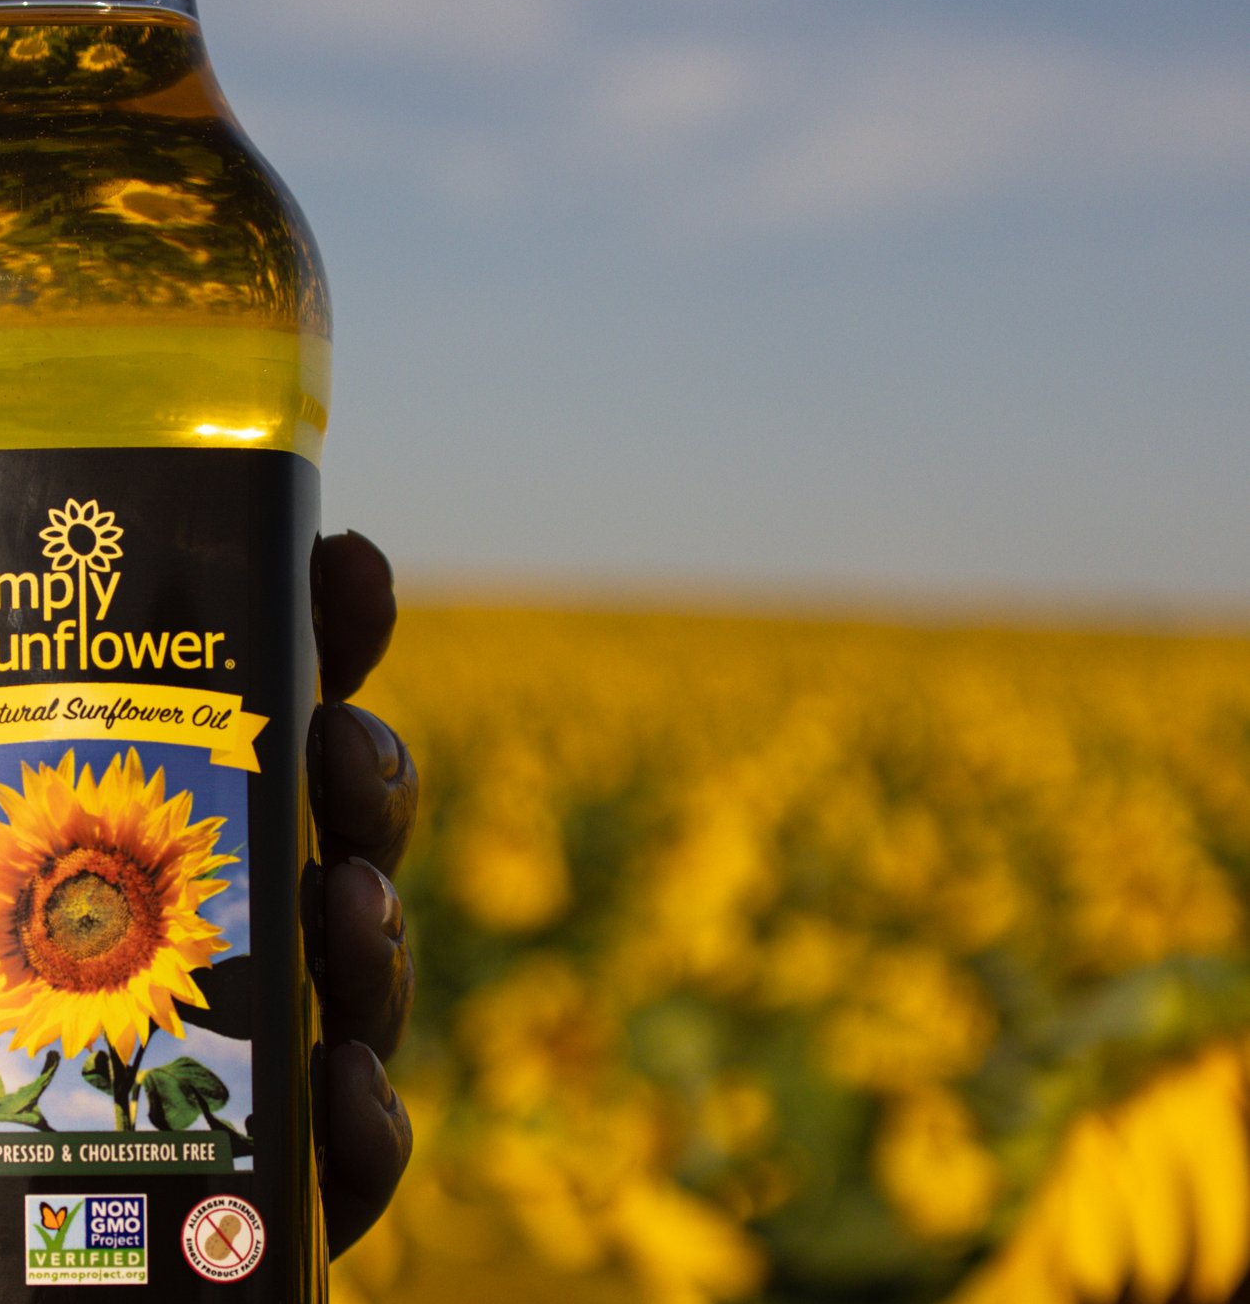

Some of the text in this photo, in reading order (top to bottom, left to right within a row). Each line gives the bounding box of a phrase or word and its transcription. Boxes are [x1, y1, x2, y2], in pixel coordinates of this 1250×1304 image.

[62, 697, 184, 729] Sunflower
[192, 705, 233, 730] Oil
[61, 1145, 73, 1162] &
[79, 1143, 178, 1162] CHOLESTEROL
[182, 1143, 216, 1161] FREE
[91, 1201, 139, 1217] NON
[188, 1199, 261, 1230] ALLERGEN FRIENDLY
[90, 1217, 141, 1233] GMO
[91, 1233, 140, 1249] Project
[35, 1252, 141, 1266] VERIFIED
[201, 1264, 239, 1277] PRODUCT
[240, 1240, 262, 1272] FACILITY
[29, 1269, 146, 1281] nongmoproject.org
